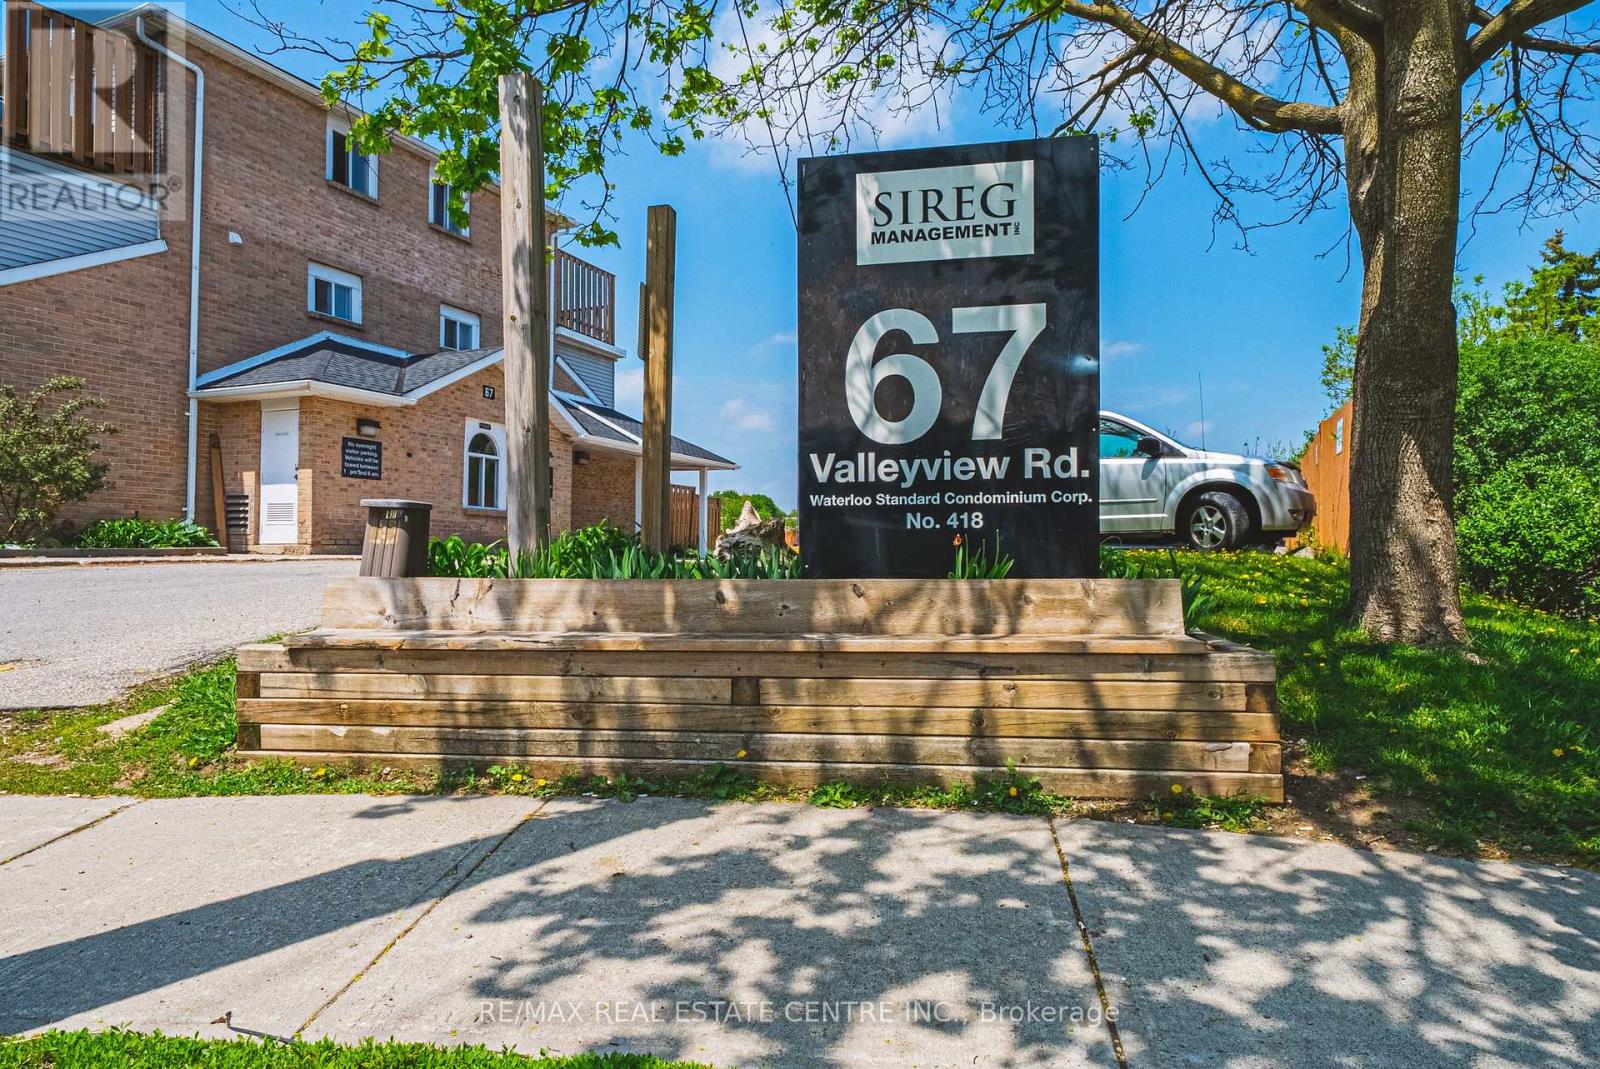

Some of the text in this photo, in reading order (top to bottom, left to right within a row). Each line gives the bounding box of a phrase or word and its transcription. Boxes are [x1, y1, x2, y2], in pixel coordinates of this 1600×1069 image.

[872, 182, 1017, 228] SIREG
[871, 222, 1012, 245] MANAGEMENT
[845, 303, 1047, 445] 67
[484, 387, 494, 398] 67
[809, 447, 1090, 488] Valleyview Rd.
[809, 490, 1093, 507] Waterloo Standard Condominium Corp.
[906, 511, 984, 529] No. 418
